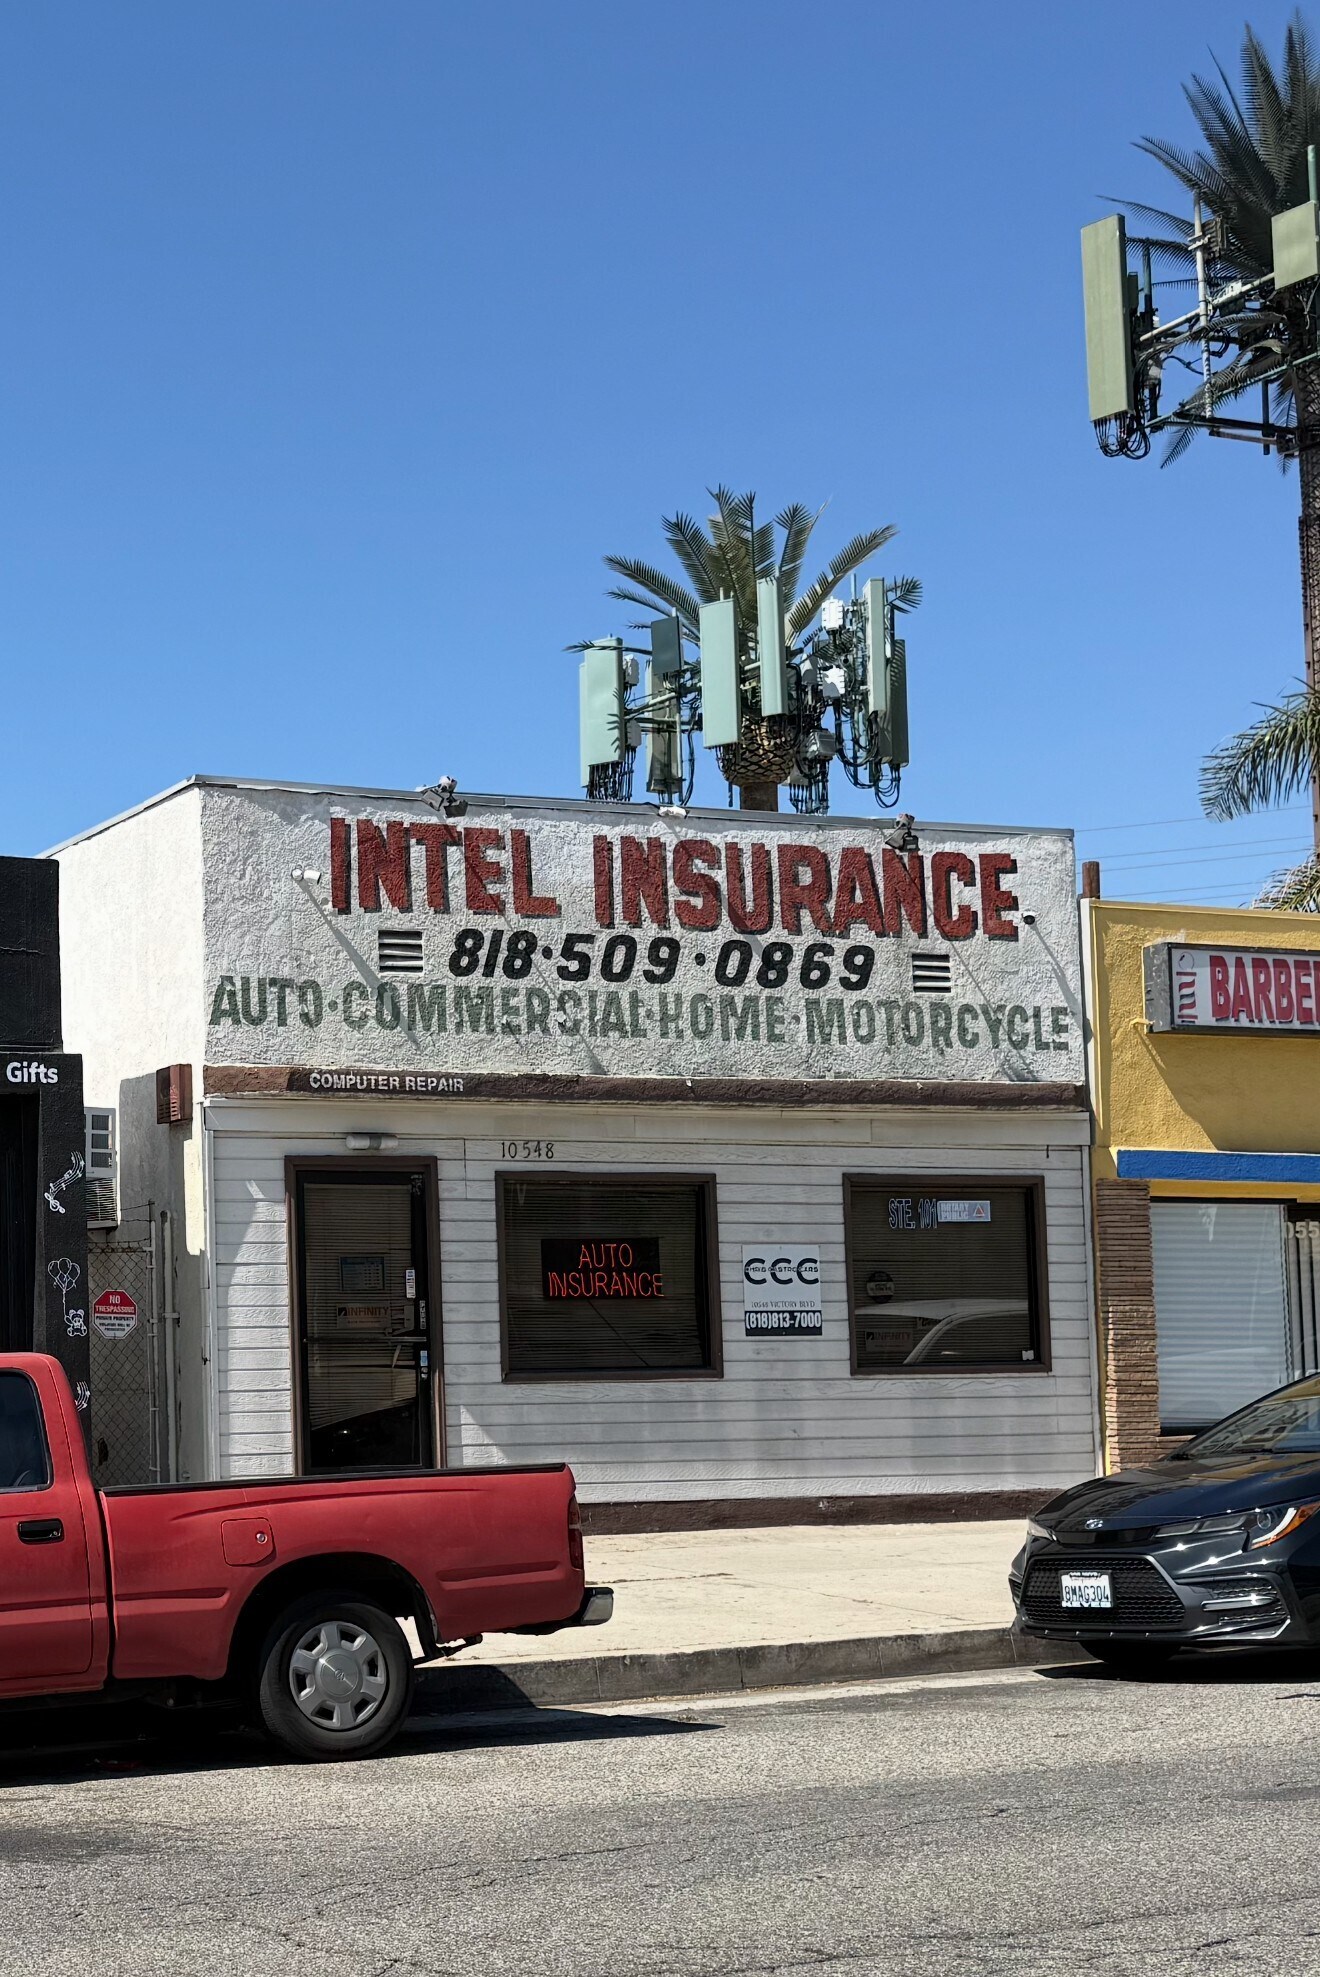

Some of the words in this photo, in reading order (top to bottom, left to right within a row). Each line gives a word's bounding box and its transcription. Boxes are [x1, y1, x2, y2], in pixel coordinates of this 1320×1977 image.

[330, 817, 562, 919] INTEL
[593, 835, 1018, 942] INSURANCE
[806, 998, 1070, 1052] MOTORCYCLE
[6, 1062, 59, 1084] Gifts
[309, 1072, 399, 1091] COMPUTER
[405, 1076, 464, 1092] REPAIR
[501, 1141, 555, 1159] 10548
[918, 1198, 938, 1229] 101
[941, 1211, 969, 1220] PUBLIC
[578, 1243, 633, 1269] AUTO
[744, 1257, 820, 1285] CCC
[548, 1272, 665, 1298] INSURANCE
[95, 1305, 135, 1313] TRESPASSING
[109, 1294, 121, 1304] NO
[348, 1306, 389, 1316] INFINITY
[745, 1312, 822, 1330] (818)813-7000
[1064, 1585, 1109, 1602] 8MAG304
